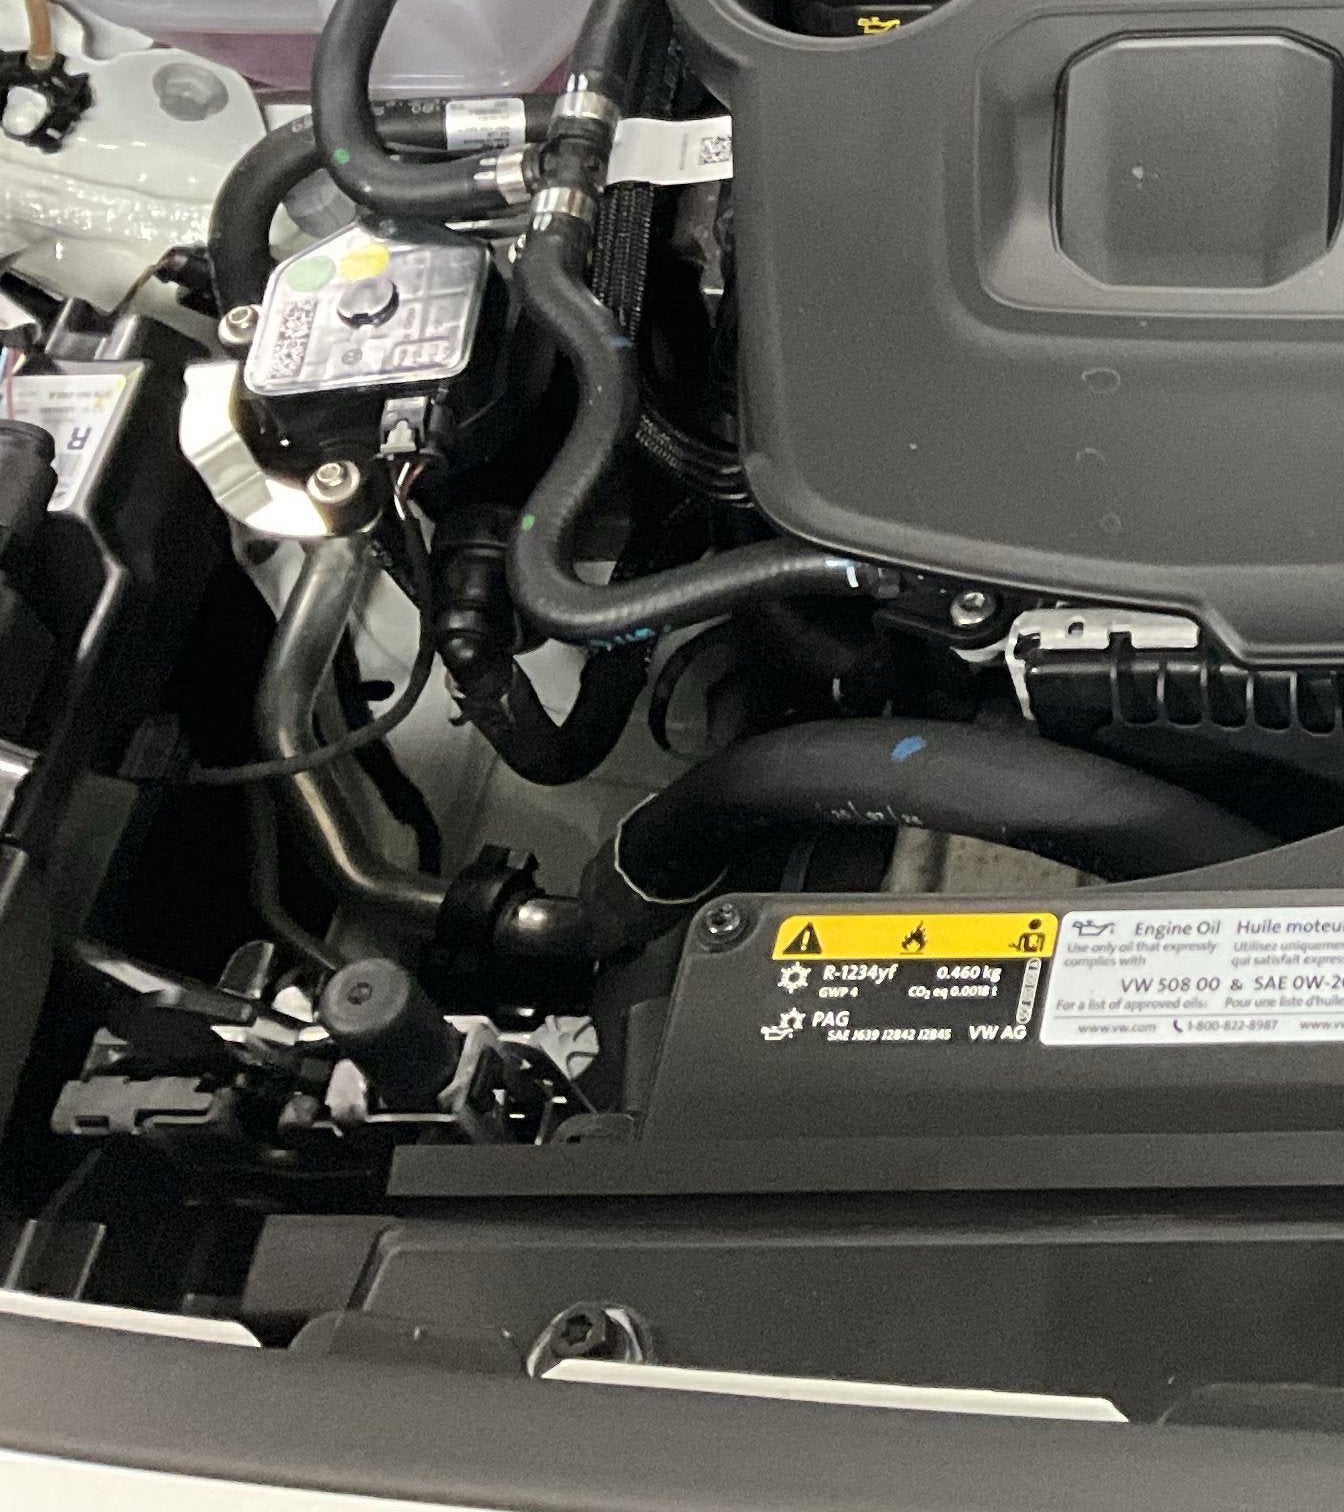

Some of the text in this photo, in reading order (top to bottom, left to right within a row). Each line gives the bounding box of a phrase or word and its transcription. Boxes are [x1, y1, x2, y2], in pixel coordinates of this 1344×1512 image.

[1135, 920, 1221, 939] Engine Oil
[1236, 919, 1283, 934] Huile
[1066, 940, 1217, 955] Use only oil that expressly
[1233, 941, 1277, 953] Utilisez
[1063, 956, 1147, 970] complies with
[1231, 955, 1251, 968] qui
[1252, 953, 1300, 966] satisfait
[822, 963, 1002, 985] R-1234yf 0.460 kg
[1120, 978, 1154, 993] VW
[1157, 977, 1191, 992] 508
[1195, 976, 1221, 991] 00
[1230, 978, 1244, 991] &
[1254, 975, 1288, 990] SAE
[818, 986, 849, 998] GWP
[849, 986, 859, 998] 4
[1056, 999, 1075, 1011] For
[1077, 1001, 1085, 1010] a
[1088, 998, 1106, 1010] list
[1108, 996, 1122, 1010] of
[1124, 996, 1180, 1012] approved
[1225, 996, 1252, 1009] Pour
[1254, 997, 1276, 1008] une
[1279, 994, 1304, 1007] liste
[811, 1010, 850, 1027] PAG
[827, 1029, 850, 1041] SAE
[968, 1025, 1027, 1040] VW AG
[1078, 1022, 1156, 1033] www.vw.com
